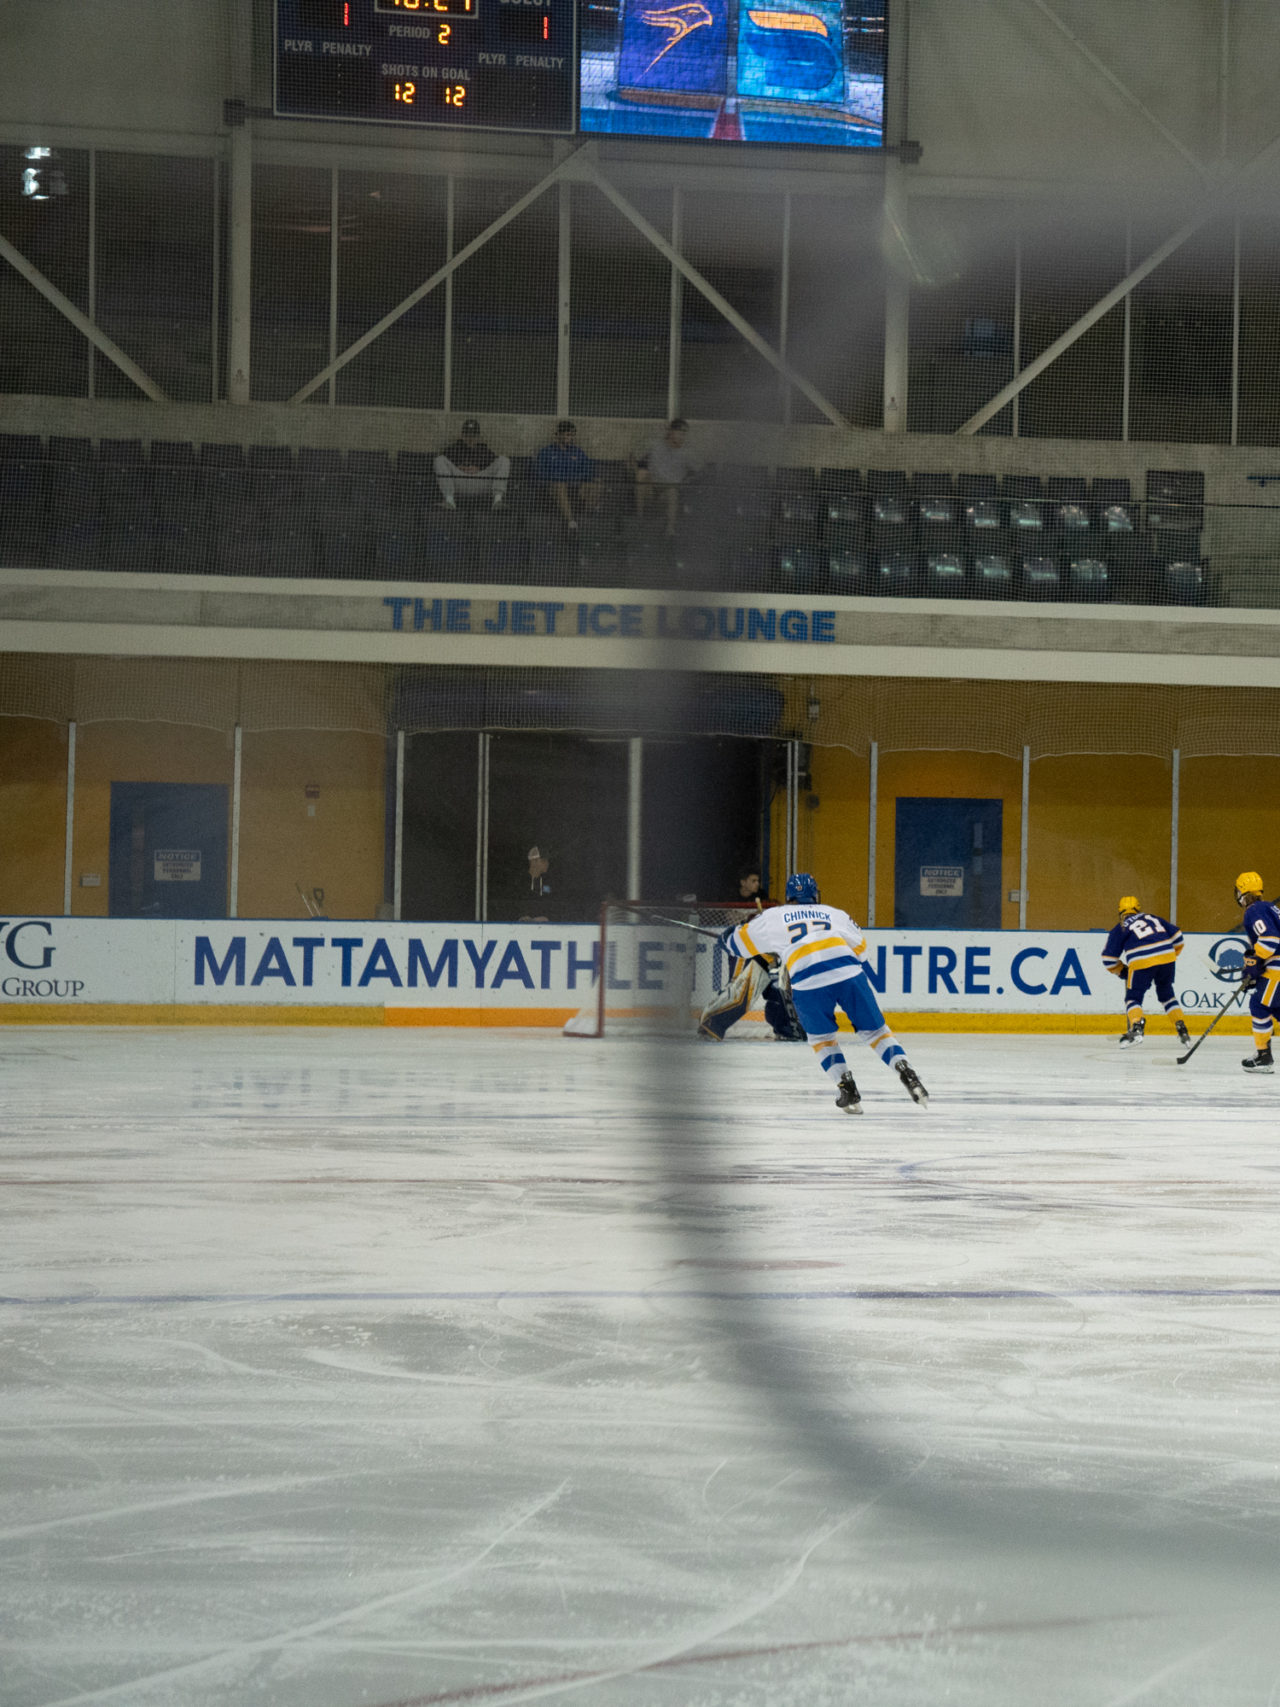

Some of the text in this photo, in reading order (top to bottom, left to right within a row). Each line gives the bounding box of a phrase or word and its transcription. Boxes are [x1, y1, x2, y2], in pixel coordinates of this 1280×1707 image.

[343, 2, 349, 26] 1
[389, 24, 451, 45] PERIOD 2
[543, 16, 549, 40] 1
[284, 39, 371, 56] PLYR PENALTY
[478, 53, 564, 69] PLYR PENALTY
[382, 63, 470, 81] SHOTS ON GOAL
[394, 82, 416, 104] 12
[445, 85, 466, 107] 12
[383, 596, 837, 643] THE JET ICE LOUNGE
[783, 910, 832, 924] CHINNICK
[1129, 914, 1166, 940] 21
[2, 977, 85, 997] GROUP
[1180, 990, 1228, 1009] OAK
